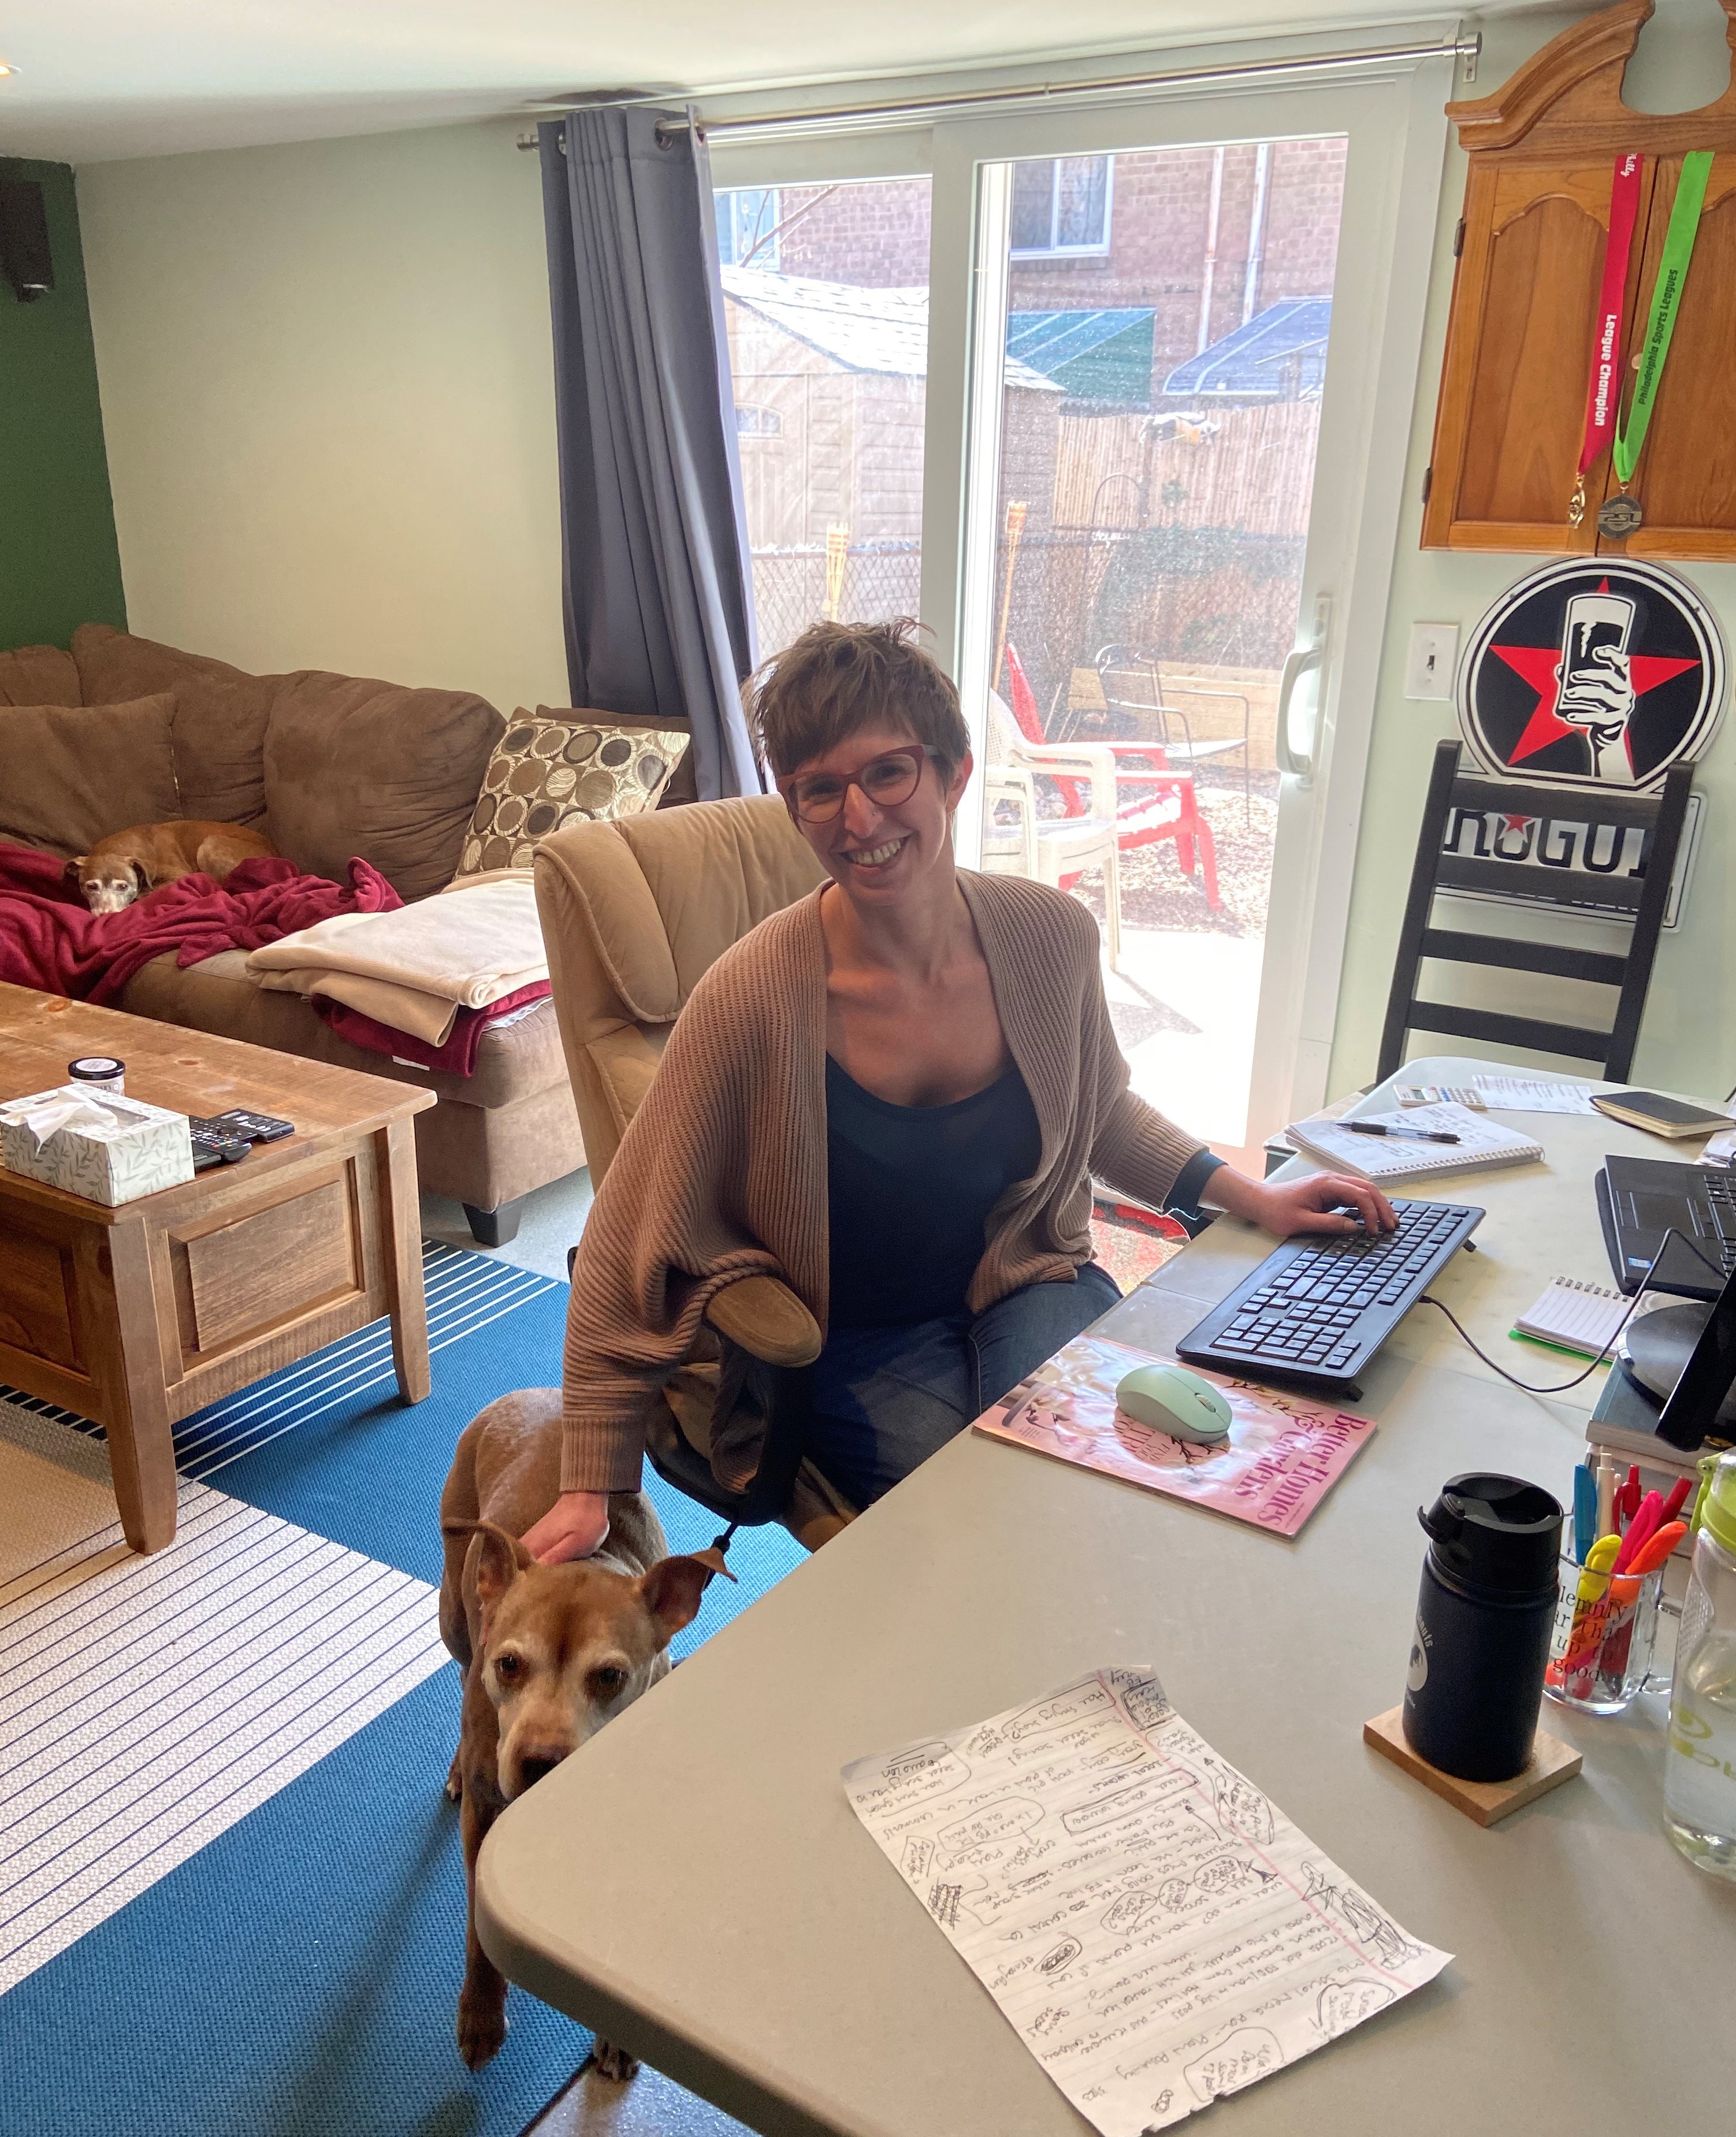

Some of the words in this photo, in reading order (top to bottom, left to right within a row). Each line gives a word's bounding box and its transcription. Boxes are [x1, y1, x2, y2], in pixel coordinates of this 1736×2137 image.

[1599, 314, 1617, 361] League
[1638, 347, 1659, 406] Philadelphia
[1653, 312, 1669, 344] Sports
[1661, 269, 1678, 310] Leagues
[1593, 364, 1613, 427] Champion
[1443, 807, 1646, 878] ROGU
[1146, 1443, 1173, 1463] FIND
[1285, 1412, 1328, 1436] &
[1304, 1413, 1368, 1468] Better
[1230, 1426, 1315, 1504] Gardens
[1252, 1459, 1331, 1531] Homes
